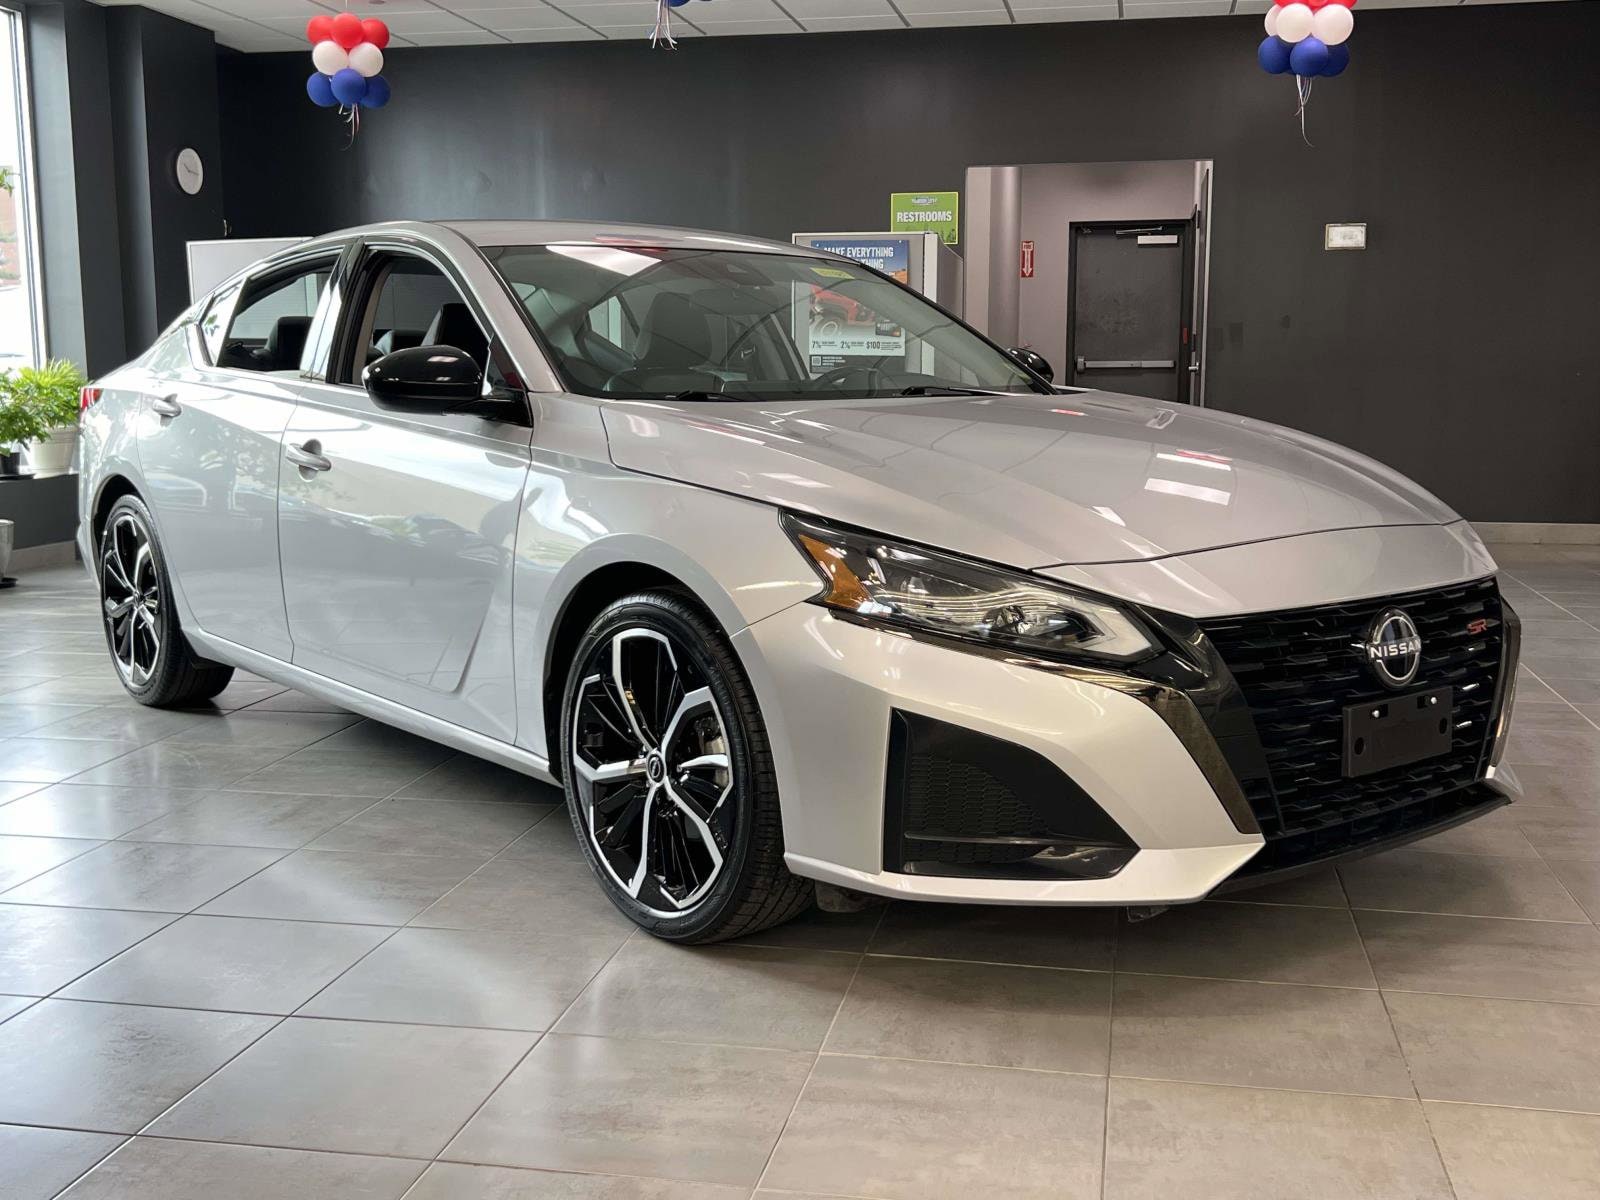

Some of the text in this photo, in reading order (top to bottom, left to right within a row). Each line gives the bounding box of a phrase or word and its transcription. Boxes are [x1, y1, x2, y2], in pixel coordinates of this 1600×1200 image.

[896, 211, 952, 223] RESTROOMS
[846, 246, 894, 258] EVERYTHING
[866, 340, 881, 350] $100
[1466, 619, 1487, 635] SR
[1370, 639, 1422, 659] NISSAN
